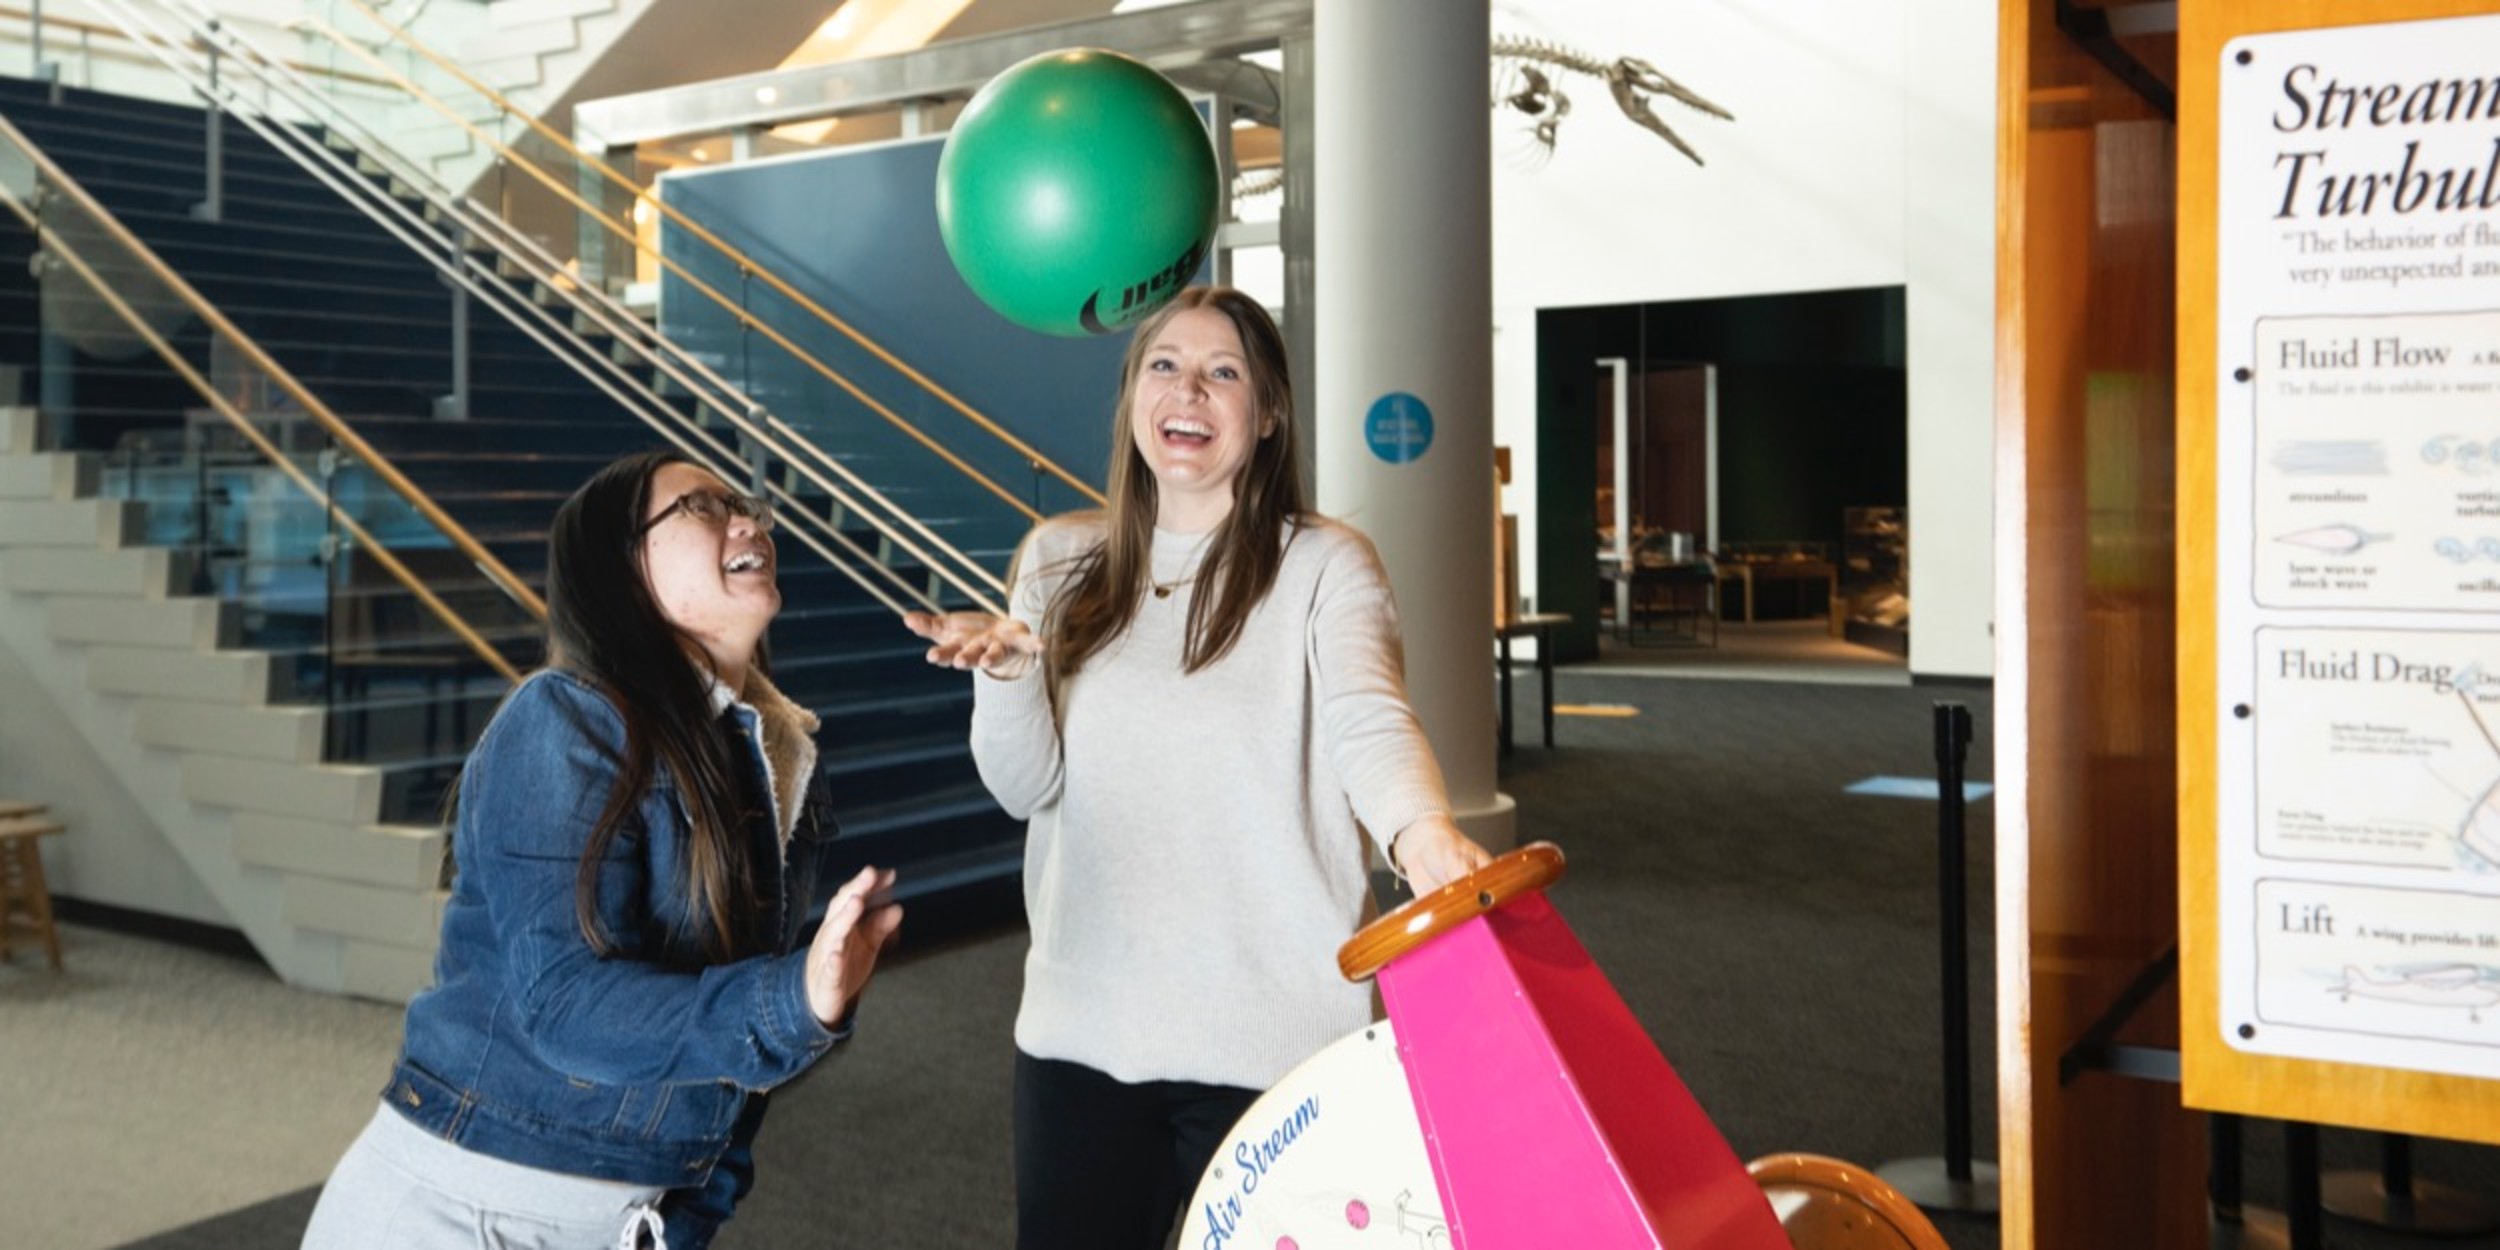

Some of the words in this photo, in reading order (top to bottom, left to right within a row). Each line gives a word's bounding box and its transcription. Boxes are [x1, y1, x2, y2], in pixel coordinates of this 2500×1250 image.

[2273, 63, 2500, 133] Stream
[2272, 137, 2500, 219] Turbul
[2345, 227, 2435, 252] behavior
[2444, 223, 2471, 247] of
[2290, 268, 2333, 288] very
[2341, 255, 2462, 287] unexpected
[2280, 338, 2358, 368] Fluid
[2374, 337, 2450, 367] Flow
[2280, 650, 2357, 680] Fluid
[2372, 652, 2454, 694] Drag
[2281, 903, 2334, 934] Lift
[2372, 930, 2405, 944] wing
[1203, 1192, 1242, 1250] Air
[1235, 1094, 1320, 1196] Stream
